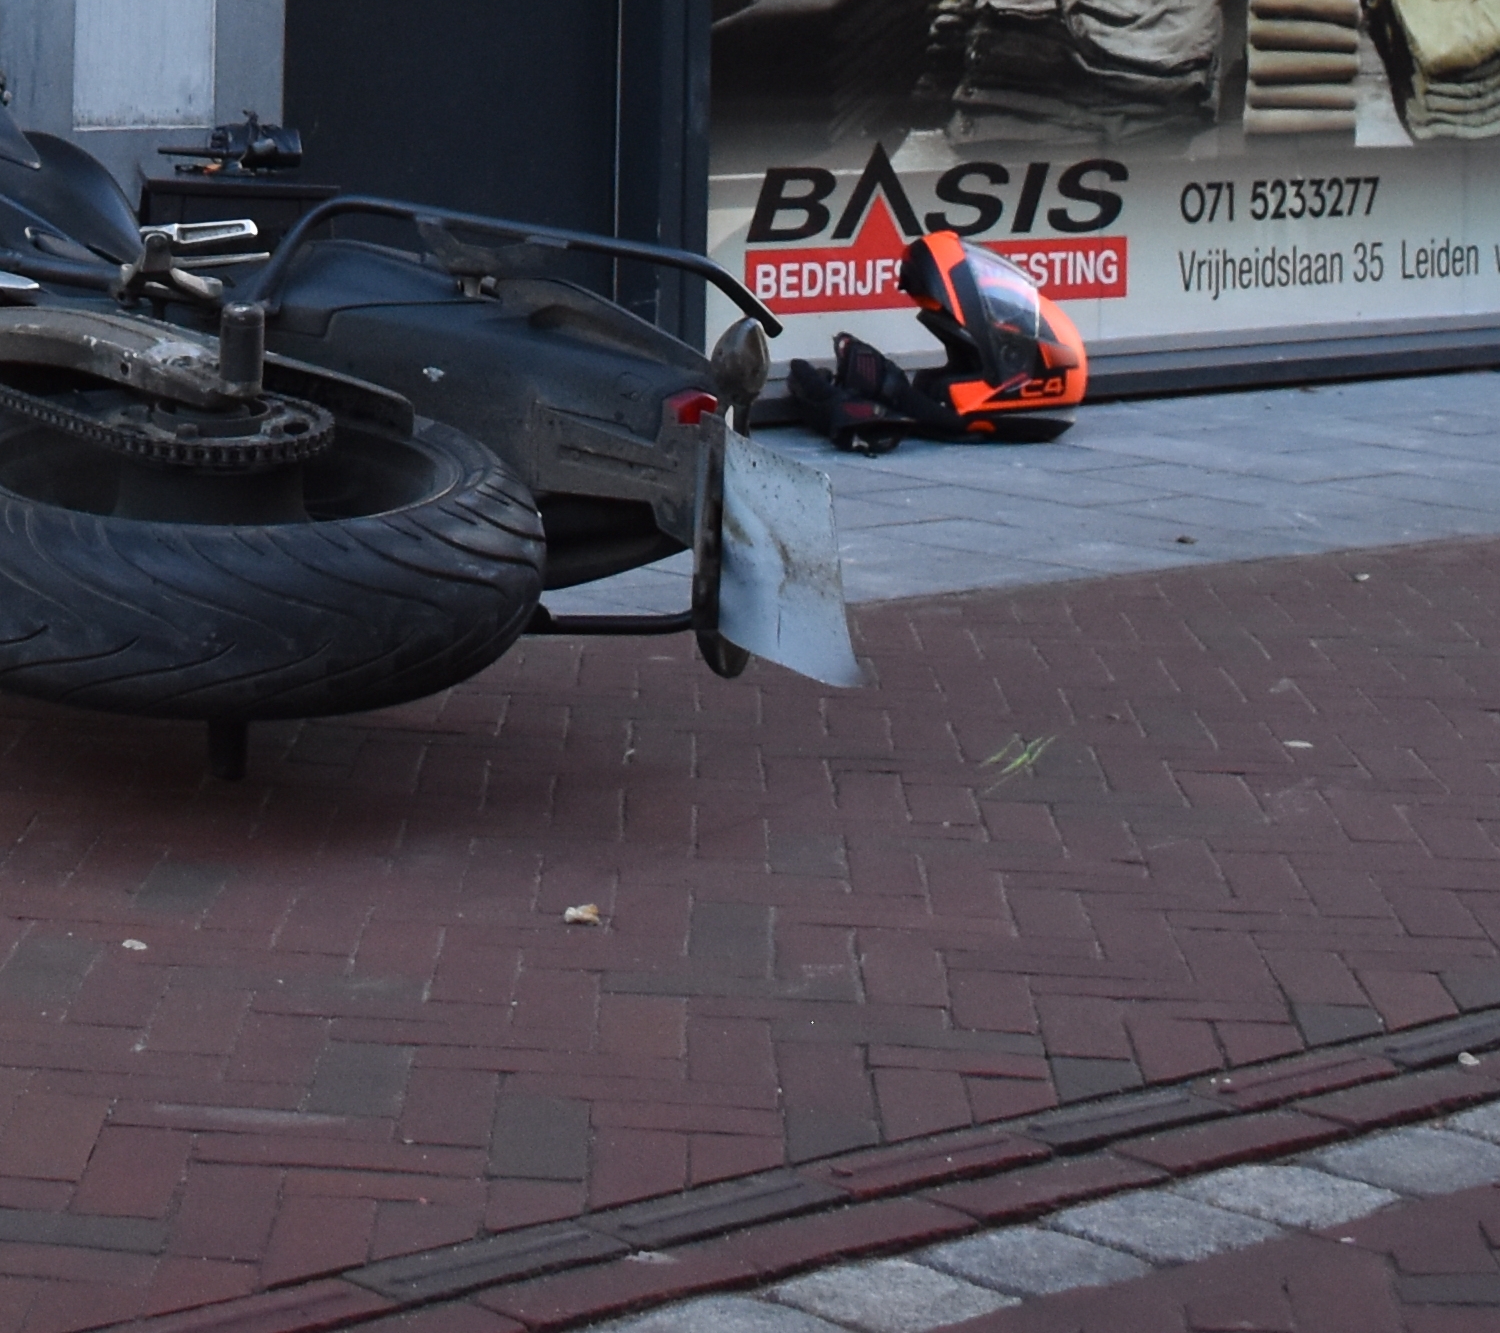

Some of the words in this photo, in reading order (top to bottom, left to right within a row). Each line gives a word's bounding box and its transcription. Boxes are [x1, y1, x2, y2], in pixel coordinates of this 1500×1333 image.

[746, 142, 1130, 243] BASIS
[1179, 181, 1236, 224] 071
[1249, 176, 1381, 221] 5233277
[1179, 244, 1344, 301] Vrijheidslaan
[1353, 240, 1385, 283] 35
[1401, 237, 1480, 281] Leiden
